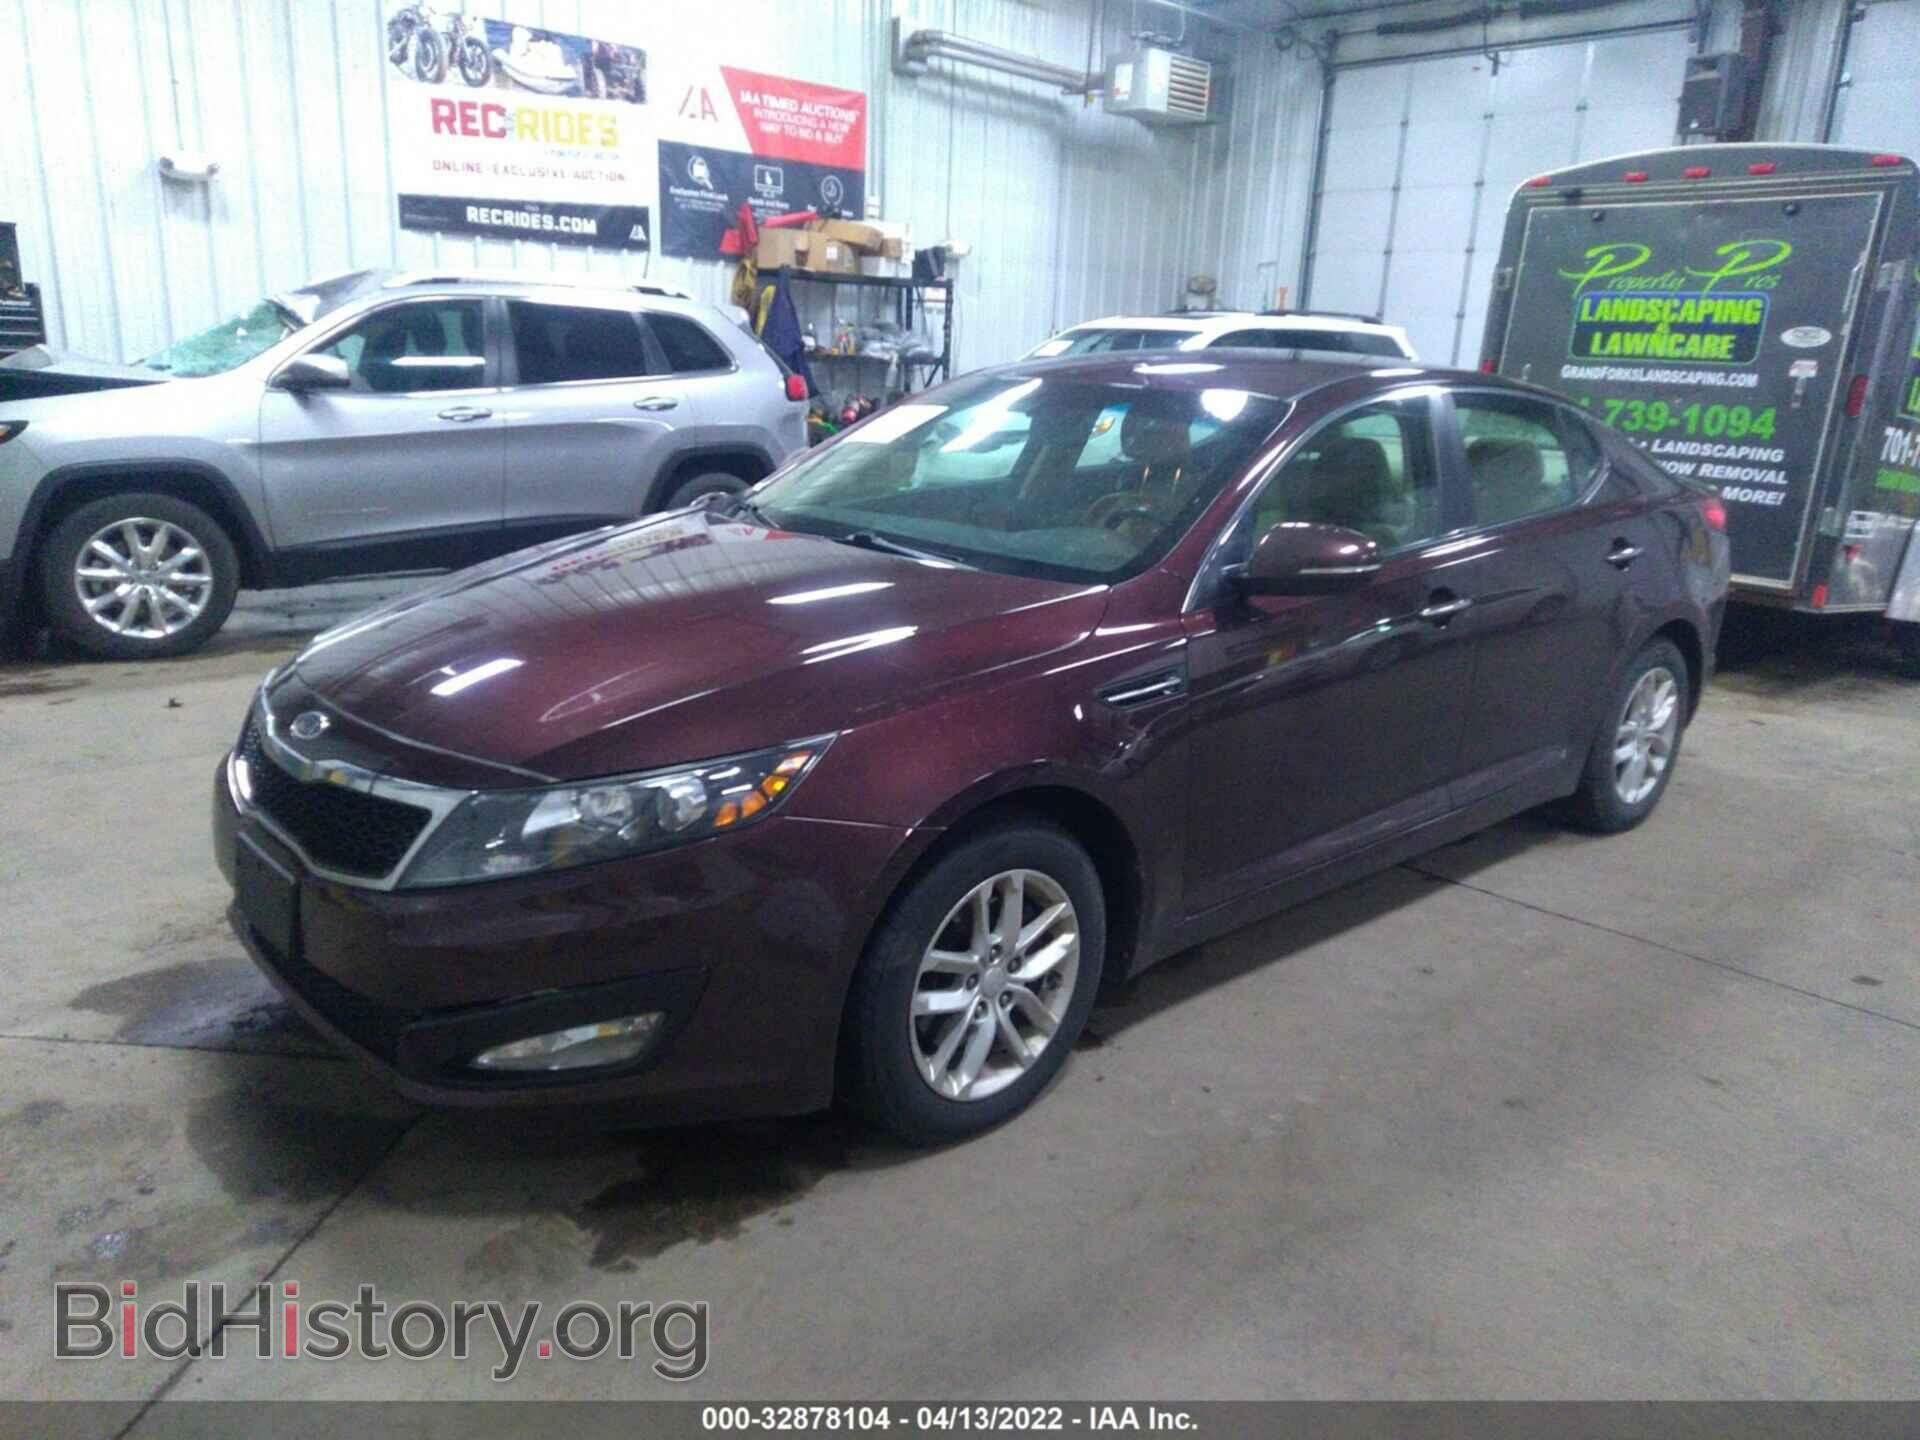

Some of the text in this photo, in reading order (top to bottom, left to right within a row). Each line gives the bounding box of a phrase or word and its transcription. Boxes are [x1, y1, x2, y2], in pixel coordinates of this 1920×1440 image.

[430, 97, 620, 148] REC RIDES
[432, 158, 626, 183] ONLINE EXCLUSIVE AUCTION
[466, 206, 597, 235] RECRIDES.COM
[1558, 239, 1793, 300] Property Pros
[1579, 297, 1764, 324] LANDSCAPING
[1589, 331, 1736, 359] LAWNCARE
[1560, 364, 1759, 388] GRANDFORKSLANDSCAPING.COM
[1650, 438, 1785, 462] LANDSCAPING
[1699, 463, 1789, 485] REMOVAL
[1721, 486, 1786, 506] MORE!
